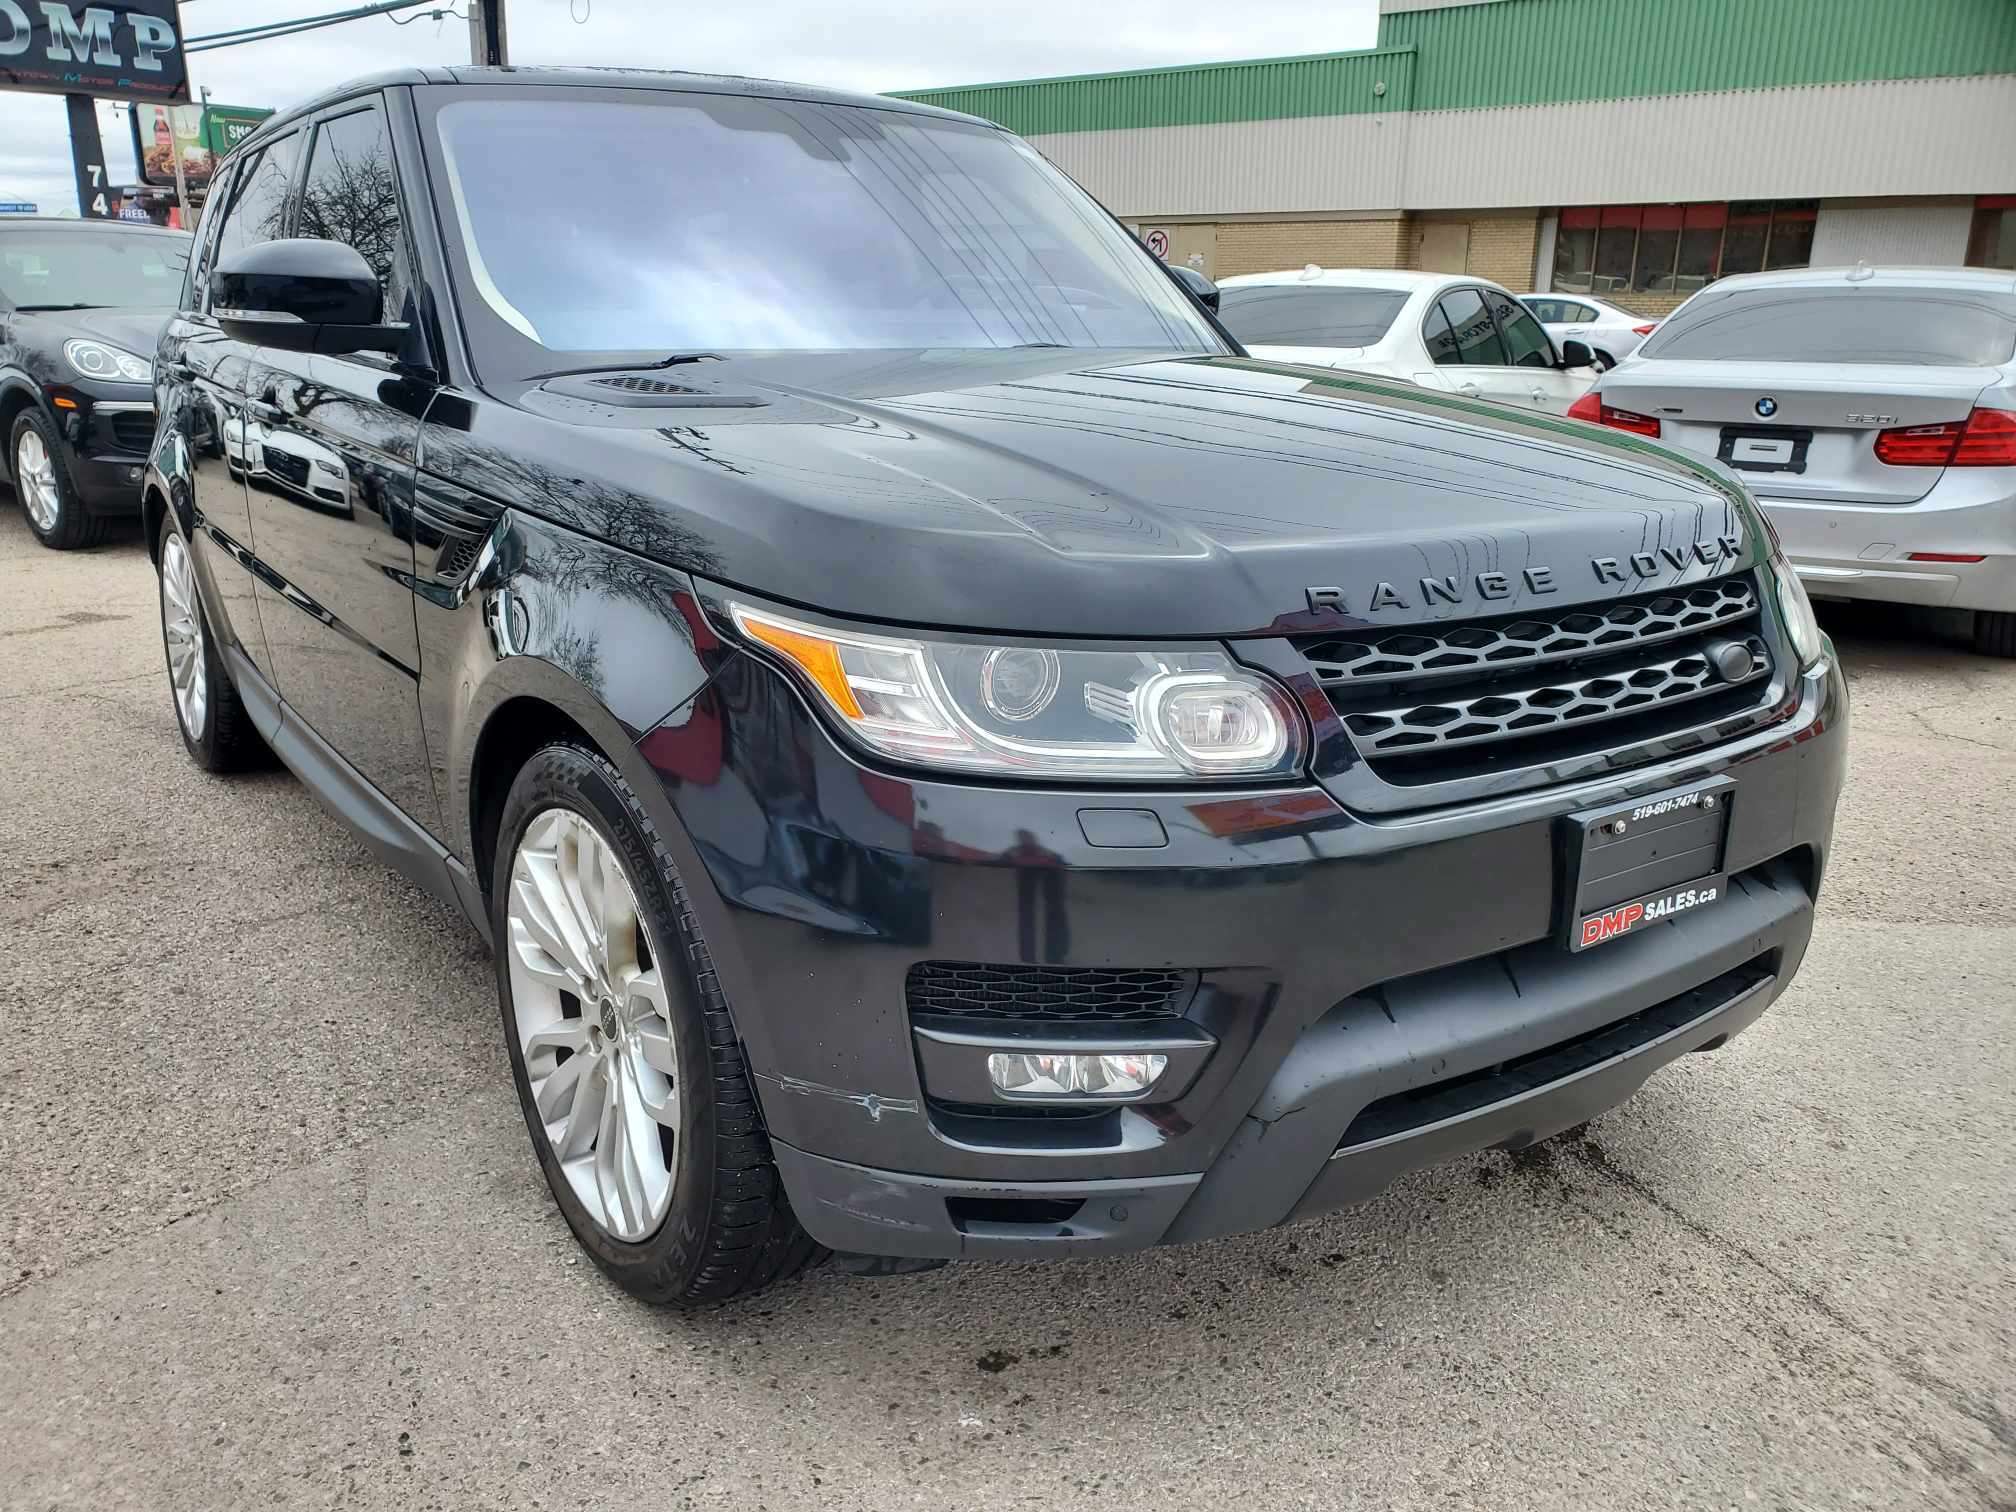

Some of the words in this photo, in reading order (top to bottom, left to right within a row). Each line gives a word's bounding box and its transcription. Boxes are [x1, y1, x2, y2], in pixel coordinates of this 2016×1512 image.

[1305, 566, 1558, 615] RANGE
[1591, 535, 1743, 584] ROVER
[1632, 792, 1700, 821] 519-601-7474
